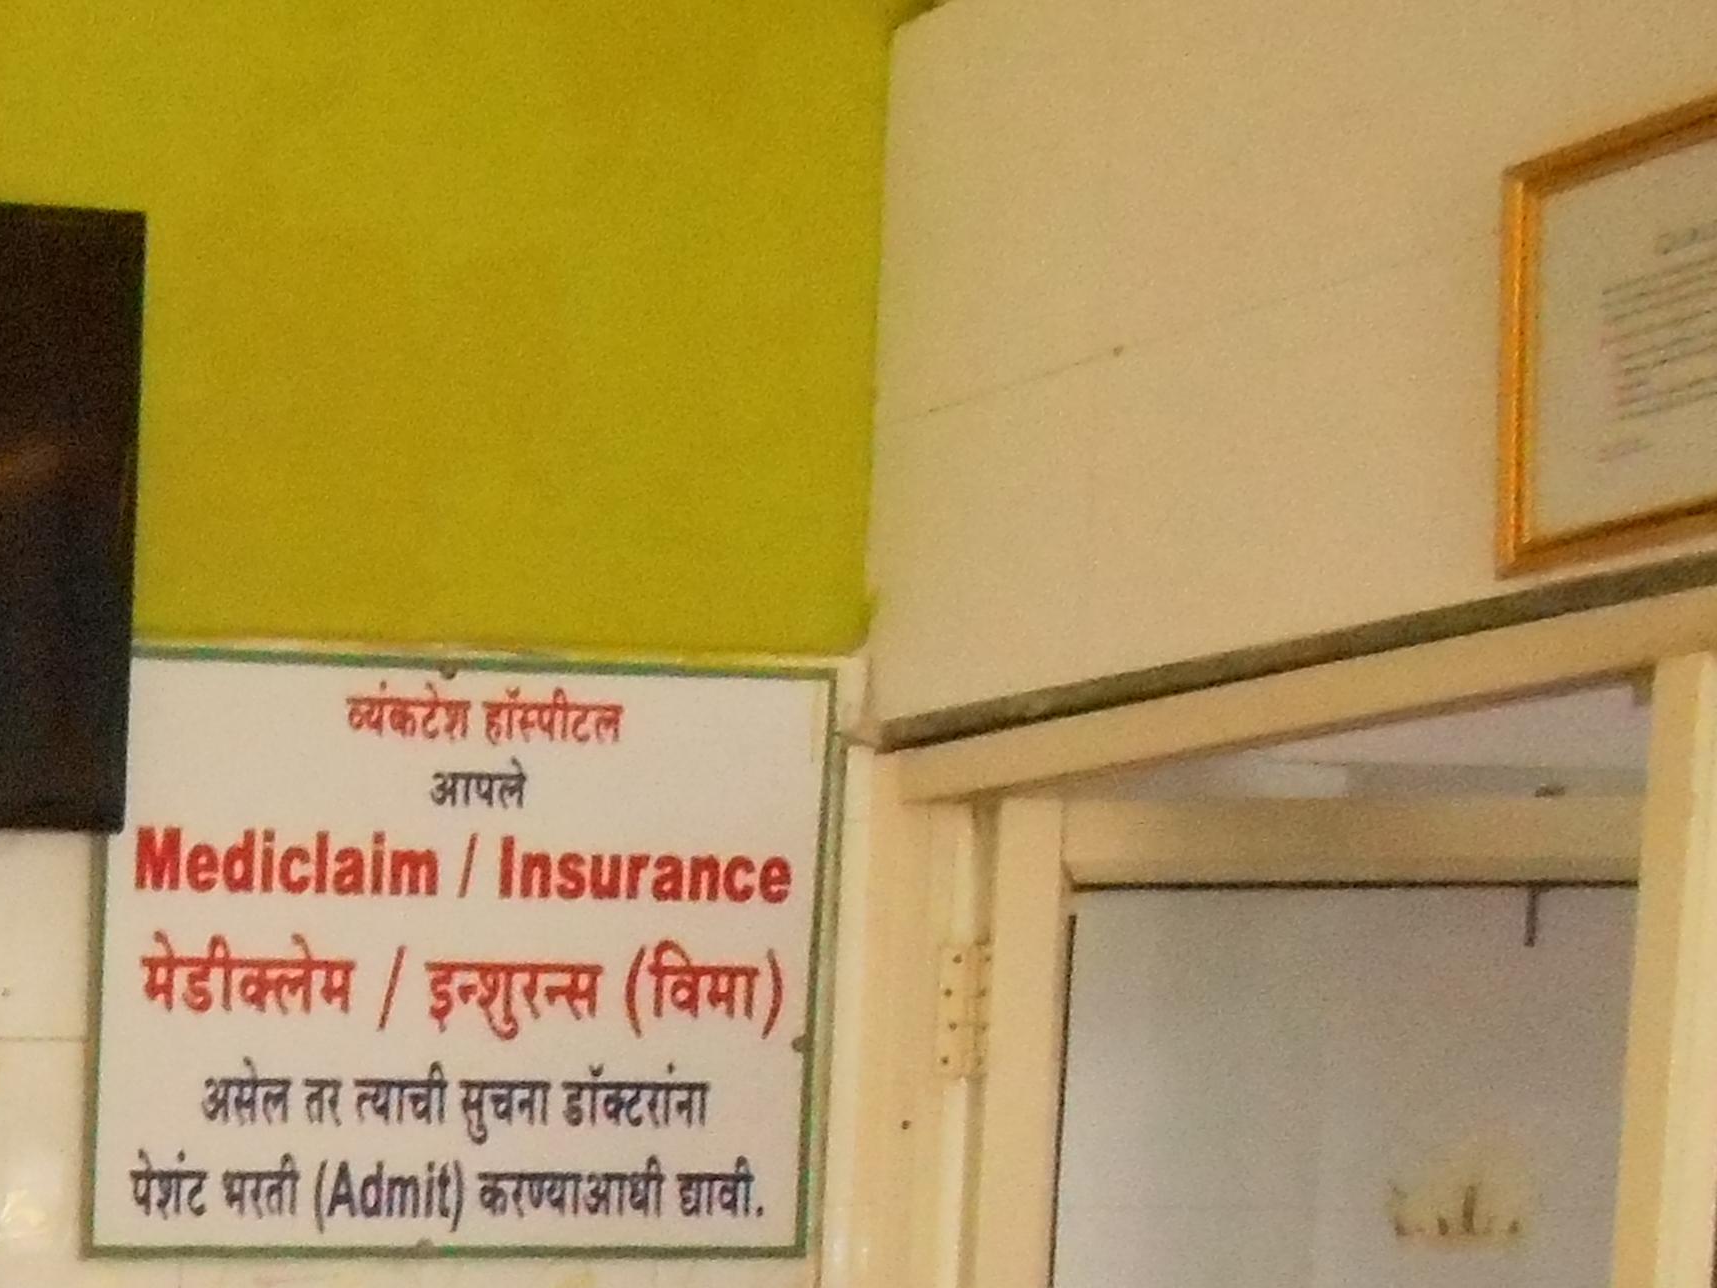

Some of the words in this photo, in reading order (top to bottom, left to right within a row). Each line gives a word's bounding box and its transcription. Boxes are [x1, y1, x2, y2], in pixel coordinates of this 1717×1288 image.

[346, 680, 470, 739] व्यंकटेश
[482, 686, 624, 745] हॉस्पीटल
[430, 755, 526, 809] आपले
[135, 826, 440, 897] Mediclaim
[498, 834, 794, 904] Insurance
[140, 929, 356, 1016] मेडीक्लेम
[423, 959, 605, 1041] इन्शुरन्स
[625, 939, 785, 1041] (विमा)
[201, 1055, 293, 1127] असेल
[303, 1078, 343, 1128] तर
[353, 1060, 449, 1127] त्याची
[459, 1079, 552, 1146] सुचना
[561, 1061, 711, 1128] डॉक्टरांना
[129, 1148, 208, 1221] पेशंट
[222, 1152, 301, 1220] भरती
[314, 1158, 466, 1235] (Admit)
